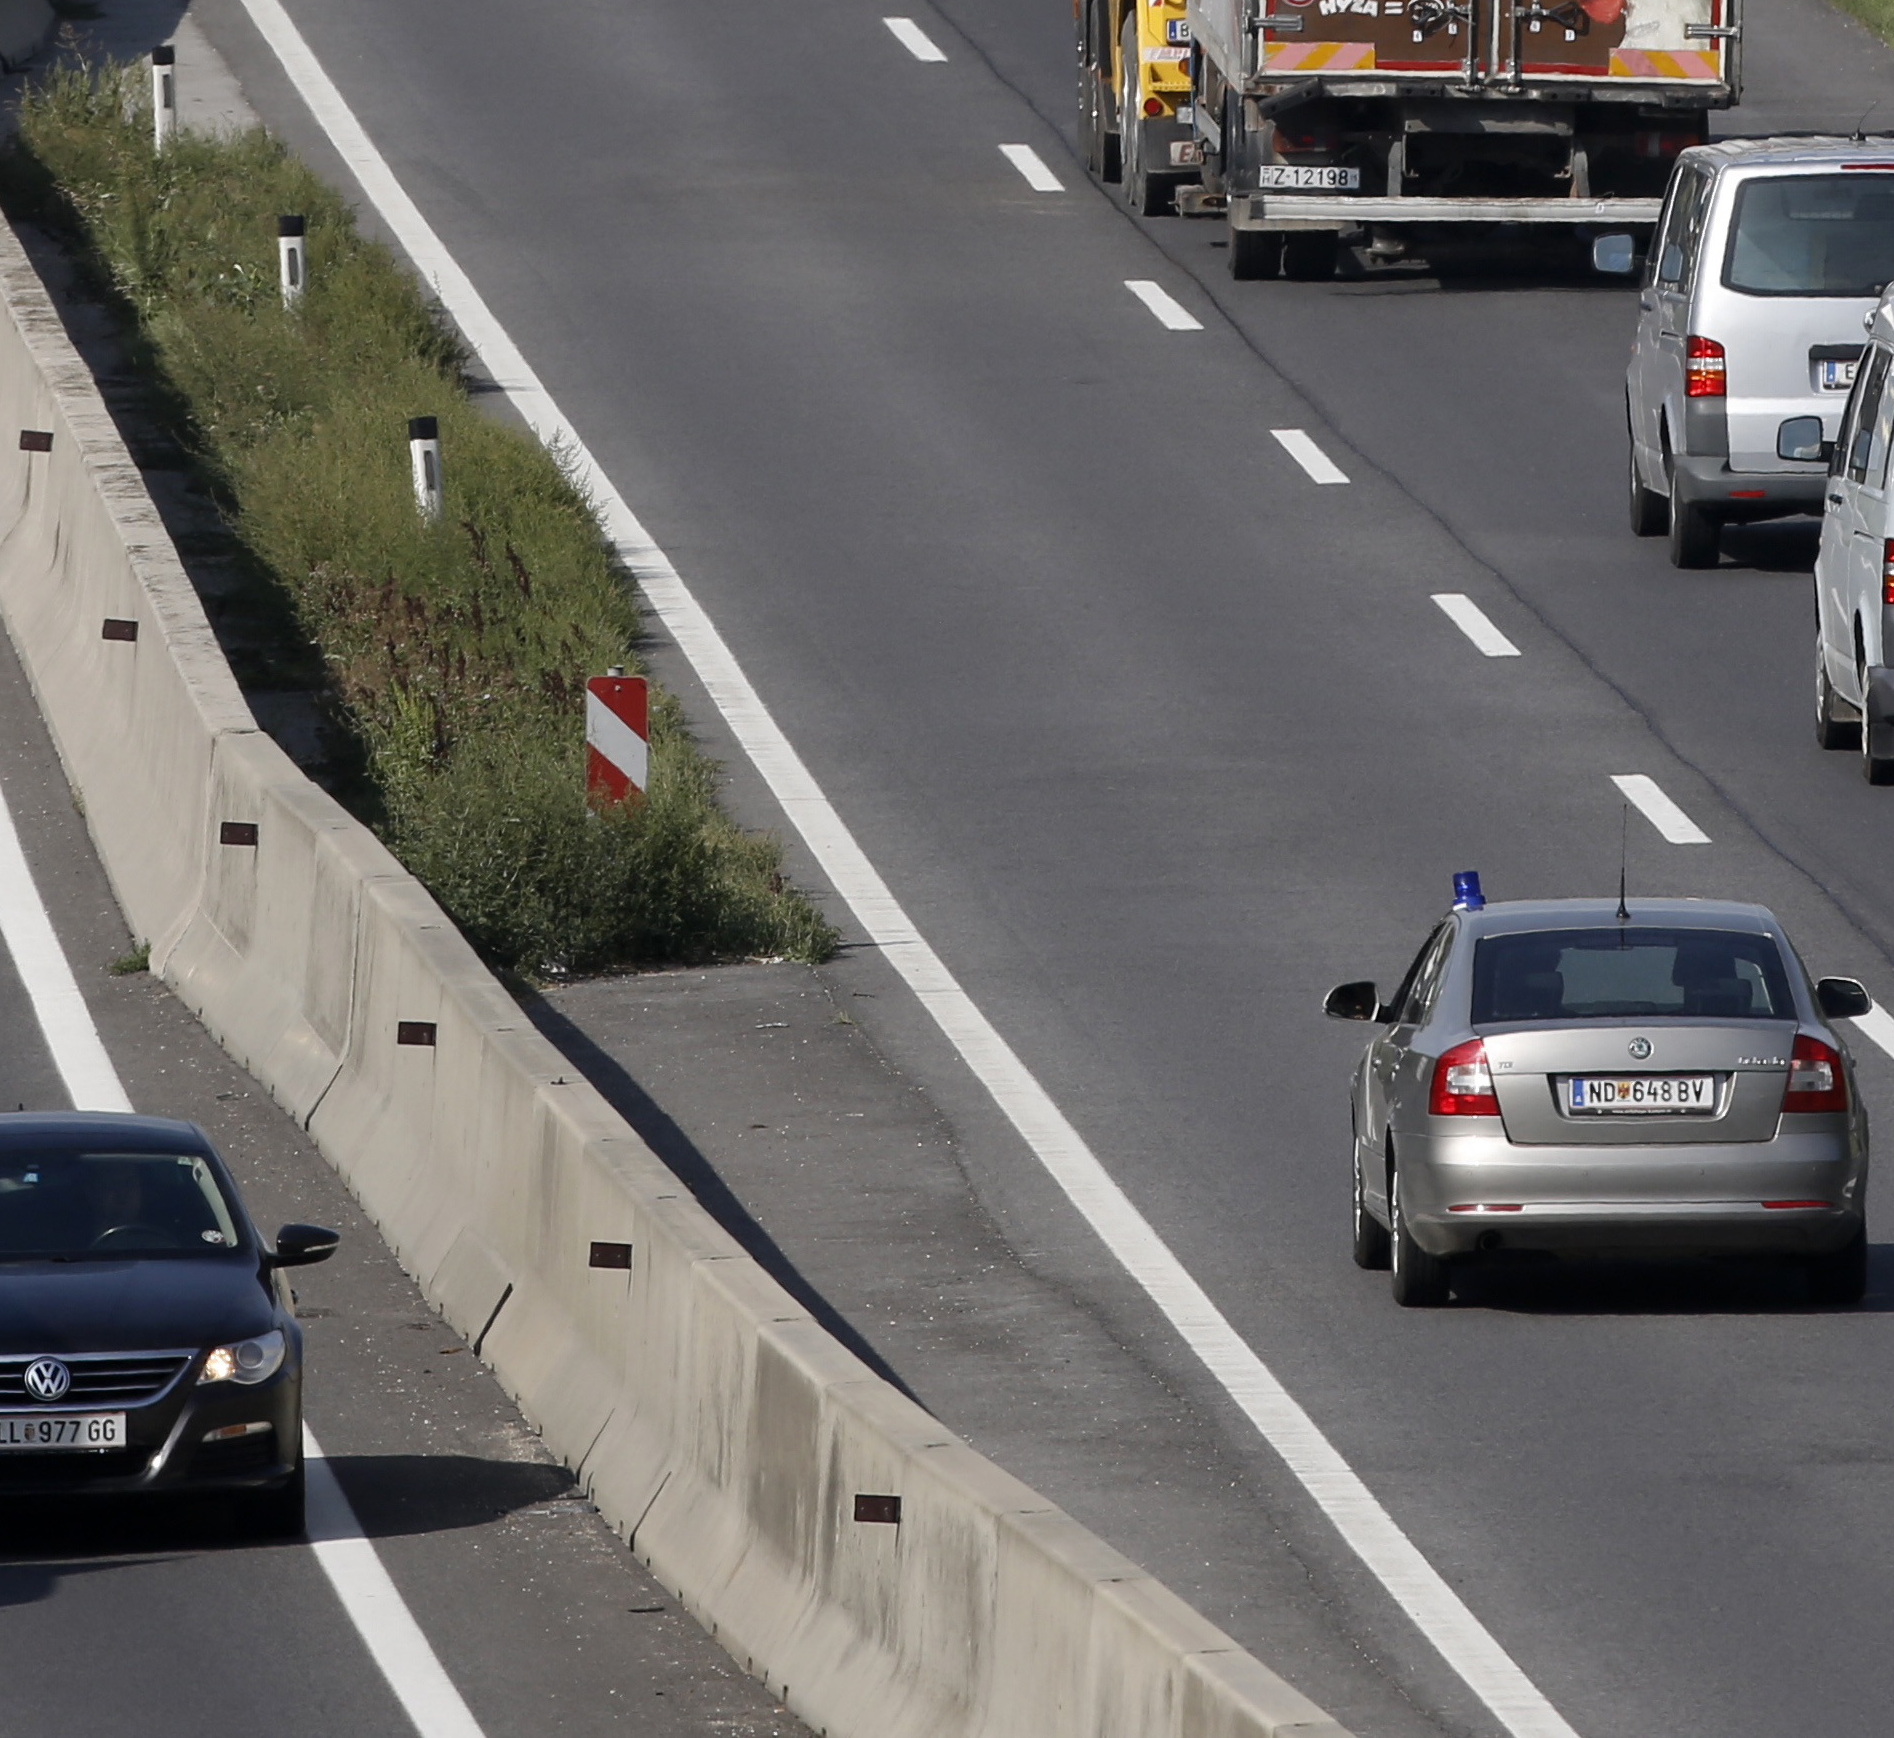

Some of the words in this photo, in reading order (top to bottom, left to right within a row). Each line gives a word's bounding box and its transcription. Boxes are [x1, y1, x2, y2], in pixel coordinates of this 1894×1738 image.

[1274, 167, 1348, 186] Z-12198
[1589, 1082, 1615, 1102] ND
[1633, 1080, 1672, 1102] 648
[1678, 1080, 1704, 1102] BV
[39, 1421, 81, 1443] 977
[88, 1419, 116, 1442] GG
